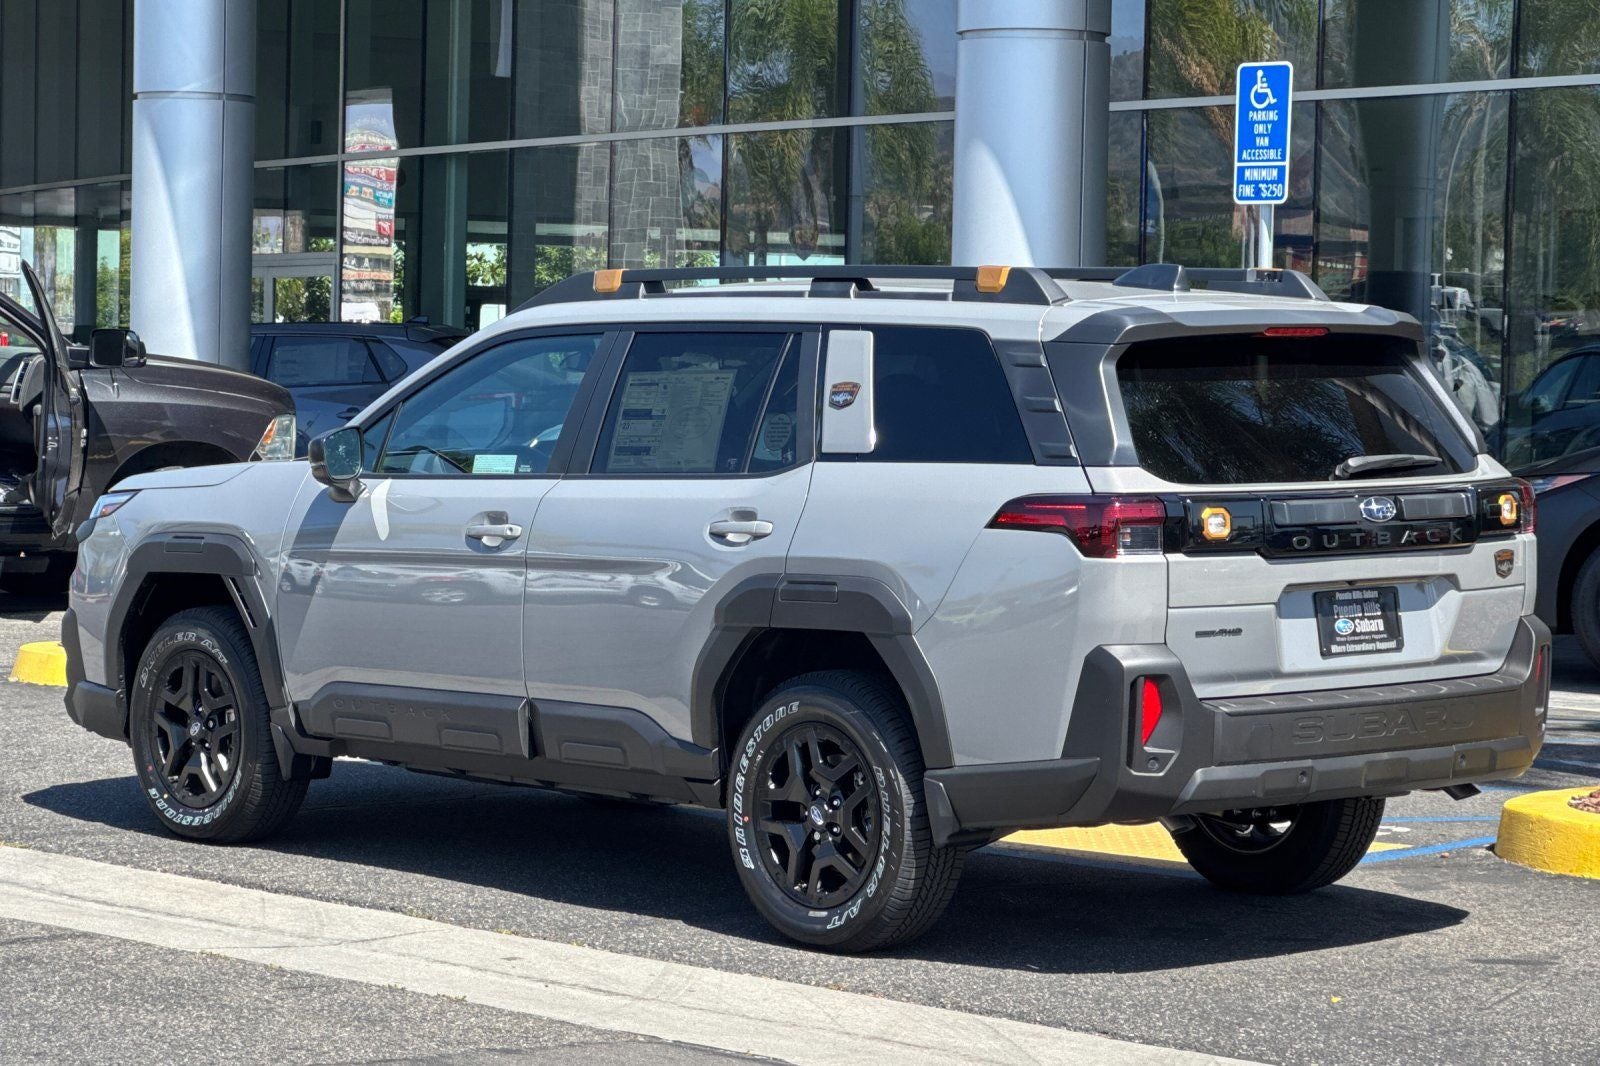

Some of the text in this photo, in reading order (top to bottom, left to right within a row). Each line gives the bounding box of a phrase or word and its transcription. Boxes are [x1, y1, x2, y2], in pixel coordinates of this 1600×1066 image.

[1248, 110, 1278, 121] PARKING
[1253, 123, 1272, 135] ONLY
[1255, 136, 1269, 147] VAN
[1241, 149, 1282, 160] ACCESSIBLE
[1244, 168, 1278, 181] MINIMUM
[1238, 184, 1255, 198] FINE
[1292, 528, 1464, 550] OUTBACK
[1333, 601, 1382, 619] Puente Hills
[1355, 618, 1384, 633] Subaru
[1331, 644, 1346, 653] Where
[139, 631, 229, 689] DUELER A/T
[1293, 704, 1473, 744] SUBARU
[733, 700, 801, 871] BRIDGESTONE
[147, 768, 243, 827] BRIDGESTONE
[826, 765, 893, 930] DUELER A/T
